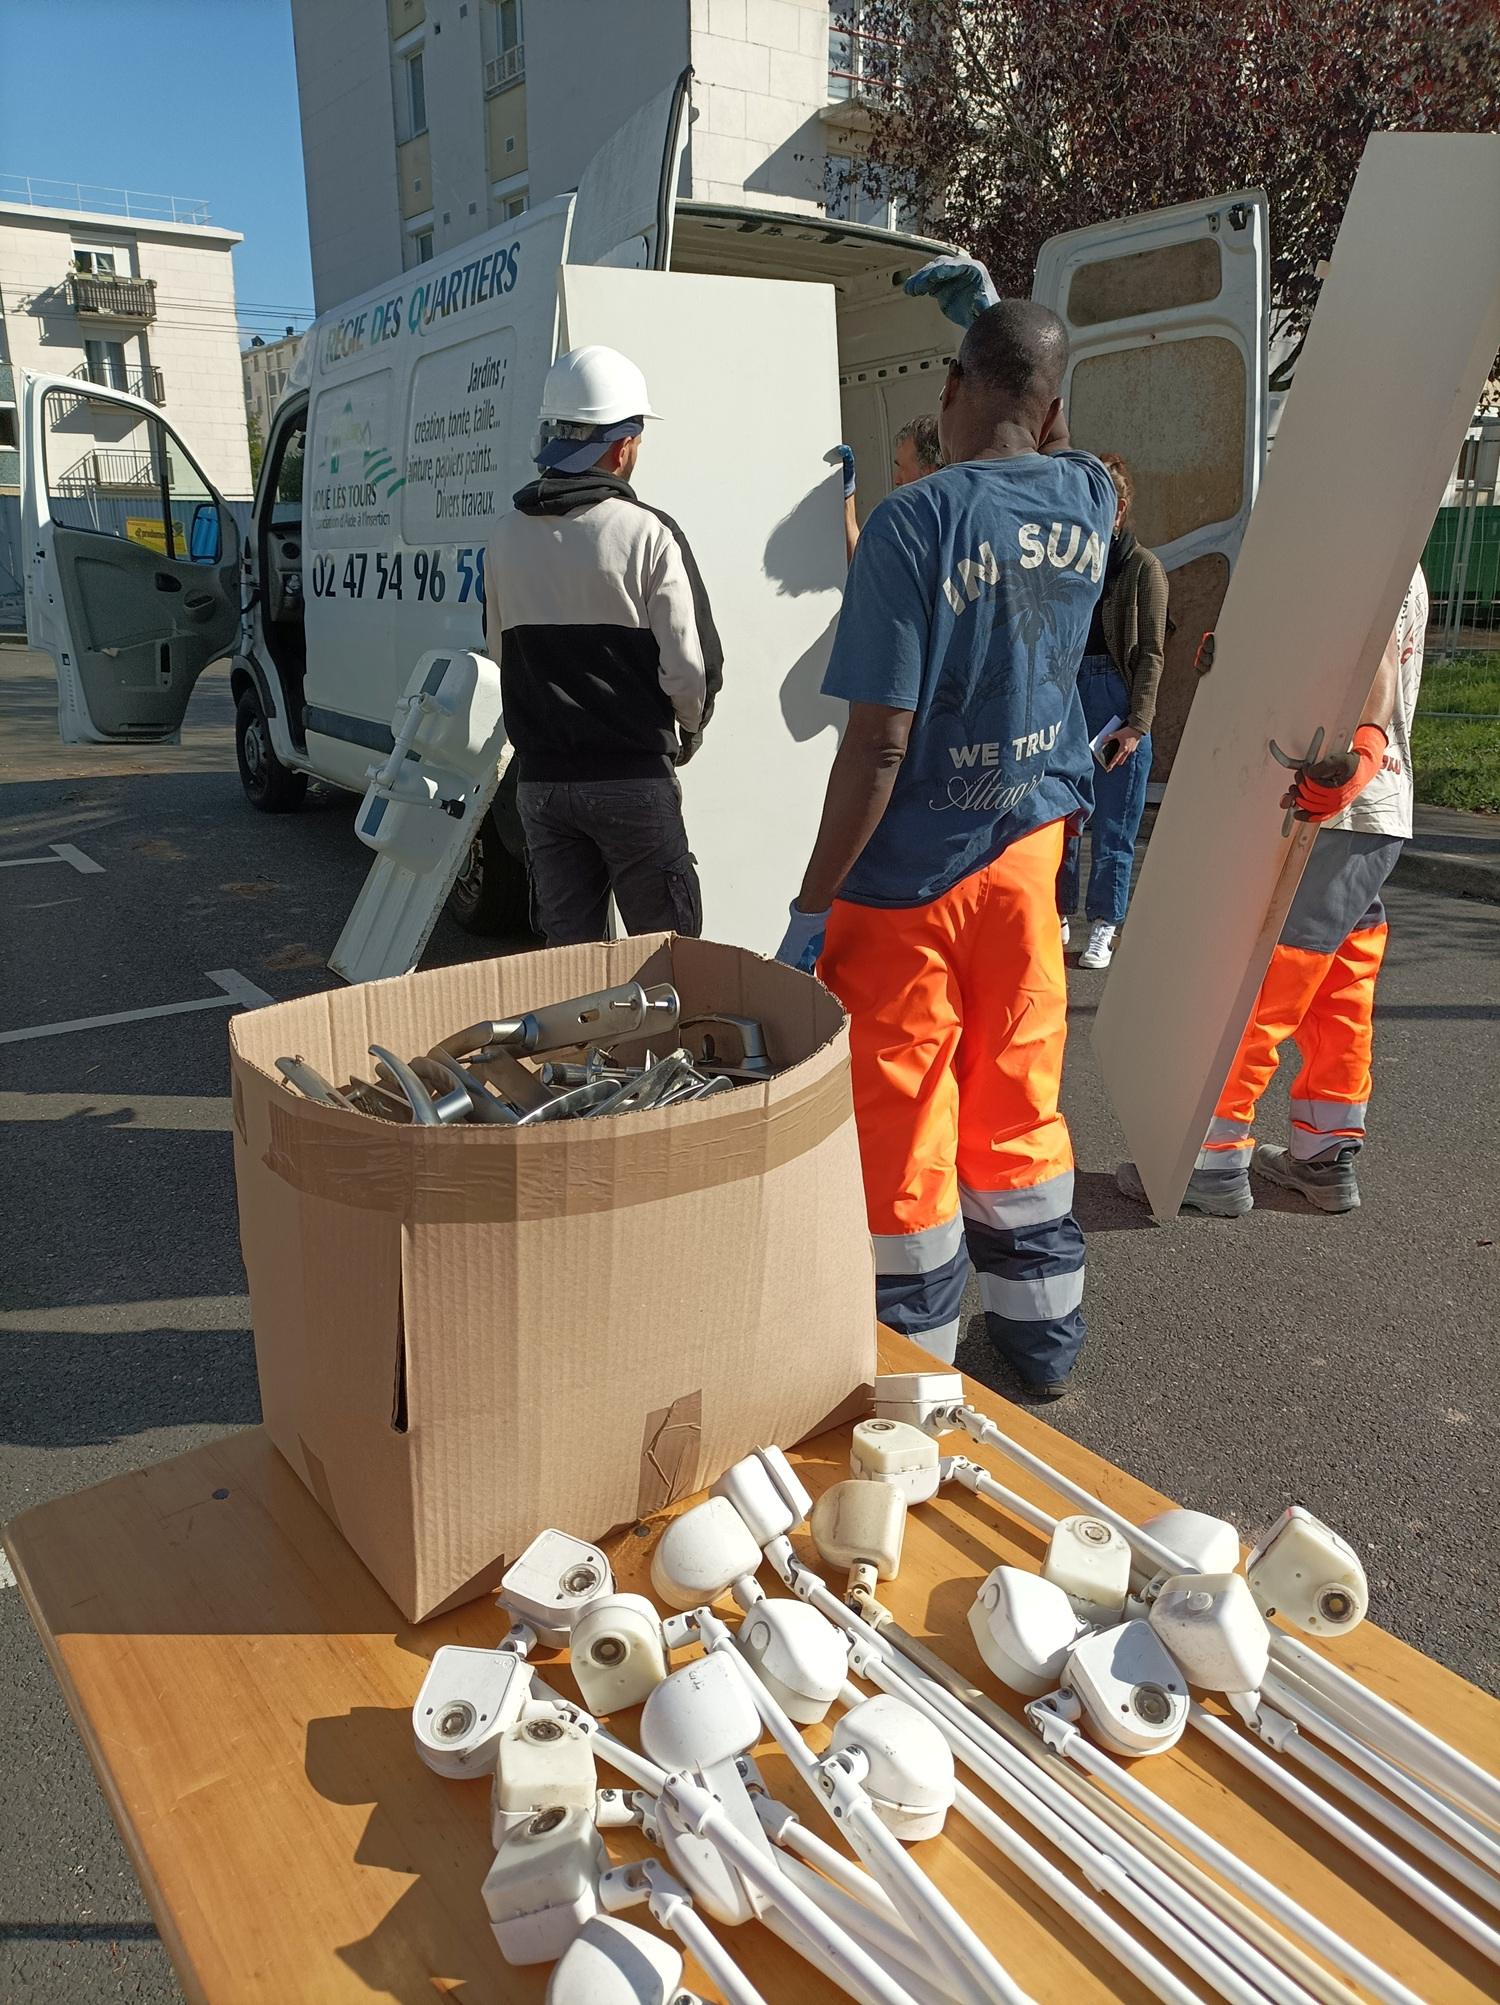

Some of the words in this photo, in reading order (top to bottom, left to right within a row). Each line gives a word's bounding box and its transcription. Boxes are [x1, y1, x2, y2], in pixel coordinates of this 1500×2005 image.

[371, 295, 403, 345] DES
[408, 240, 521, 336] QUARTIERS
[414, 411, 446, 444] création,
[448, 407, 471, 438] tonte,
[473, 399, 501, 433] taille...
[434, 448, 464, 488] papiers
[464, 443, 498, 484] peints...
[348, 482, 377, 507] TOURS
[436, 489, 460, 518] Divers
[461, 489, 496, 517] travaux.
[312, 553, 336, 598] 02
[343, 552, 368, 599] 47
[376, 551, 402, 600] 54
[414, 549, 446, 602] 96
[942, 540, 1000, 617] IN
[1018, 522, 1105, 584] SUN
[948, 742, 1000, 769] WE
